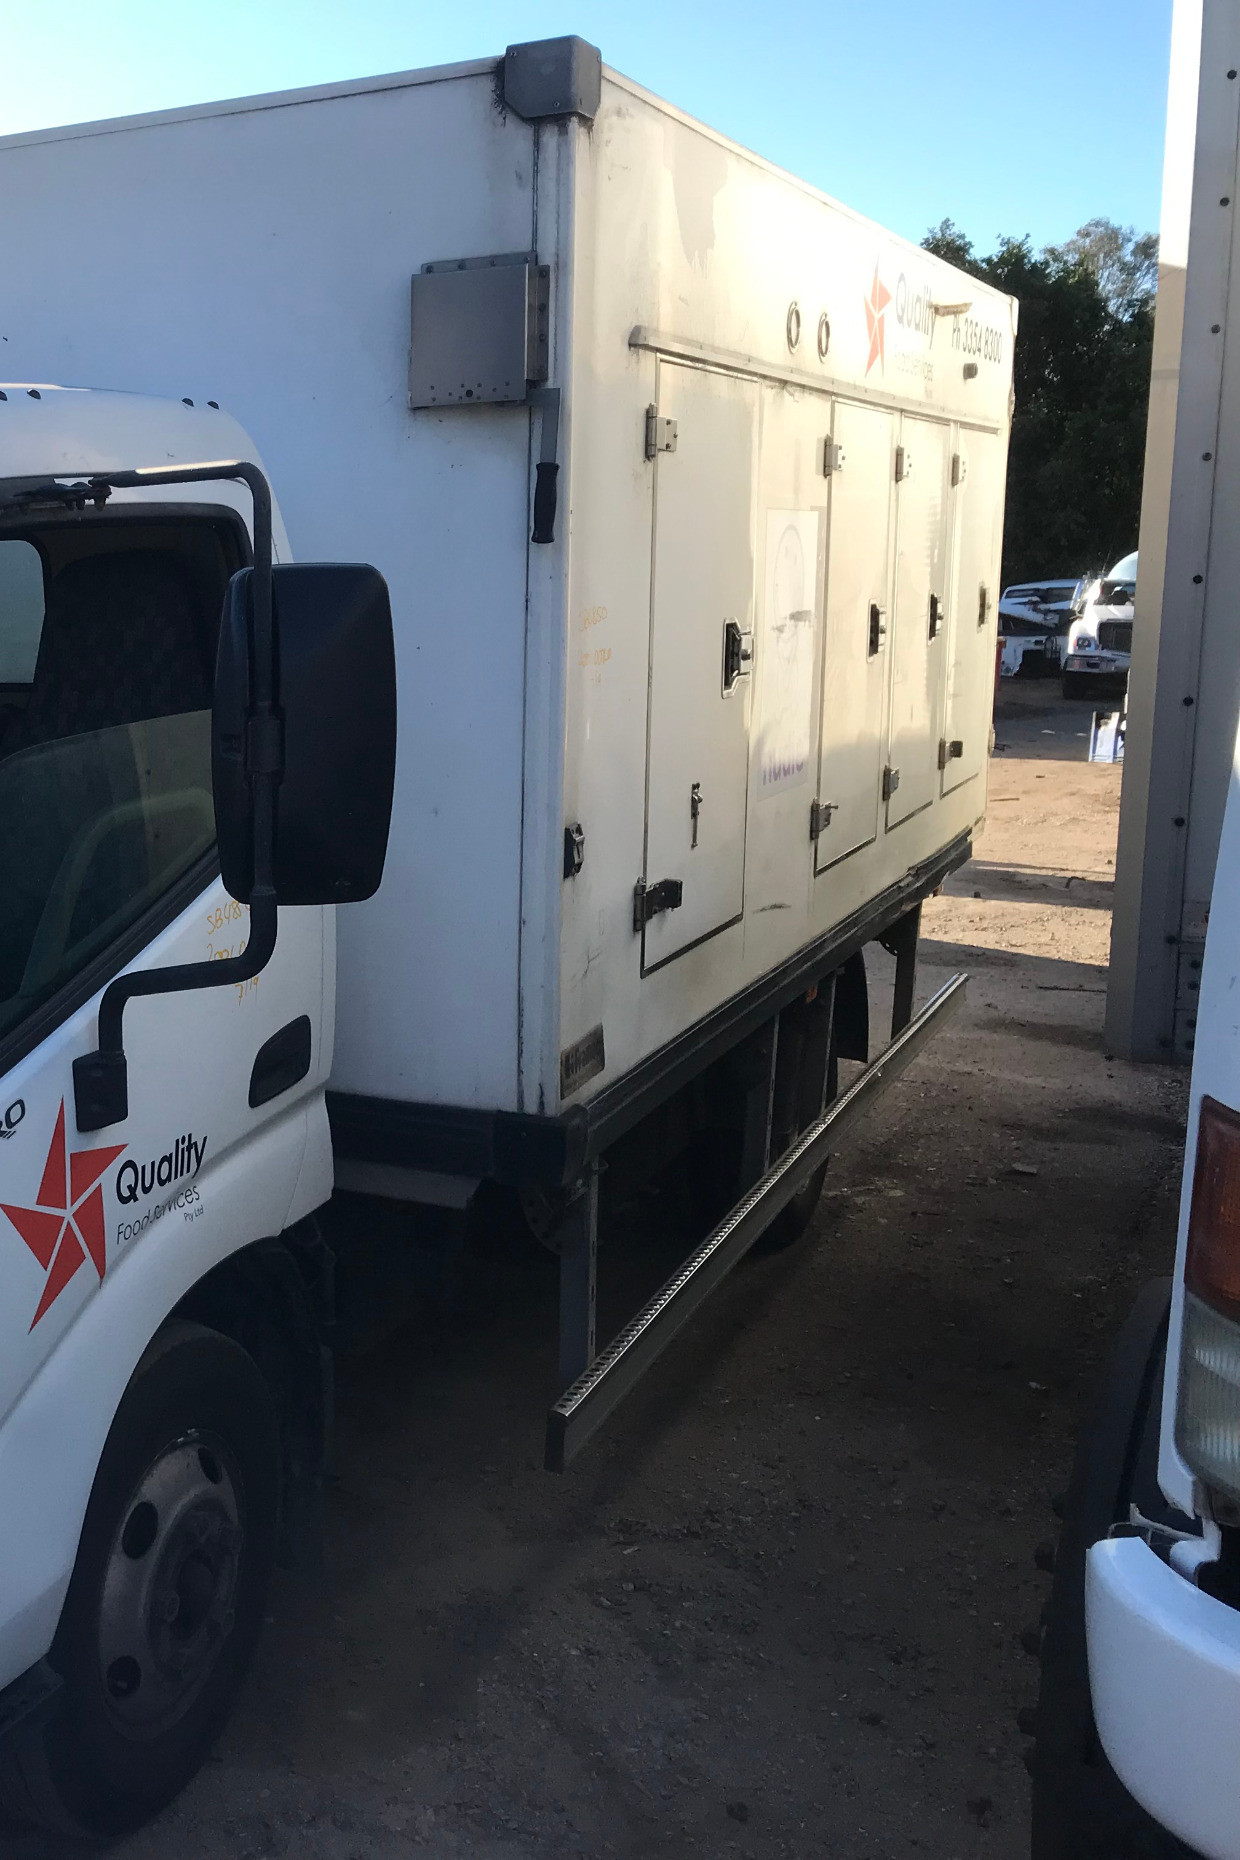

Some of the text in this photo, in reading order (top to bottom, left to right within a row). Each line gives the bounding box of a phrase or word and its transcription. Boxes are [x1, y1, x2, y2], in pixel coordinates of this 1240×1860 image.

[895, 272, 937, 350] Quality
[963, 317, 982, 357] 3354
[984, 326, 1002, 364] 8300
[116, 1133, 207, 1205] Quality
